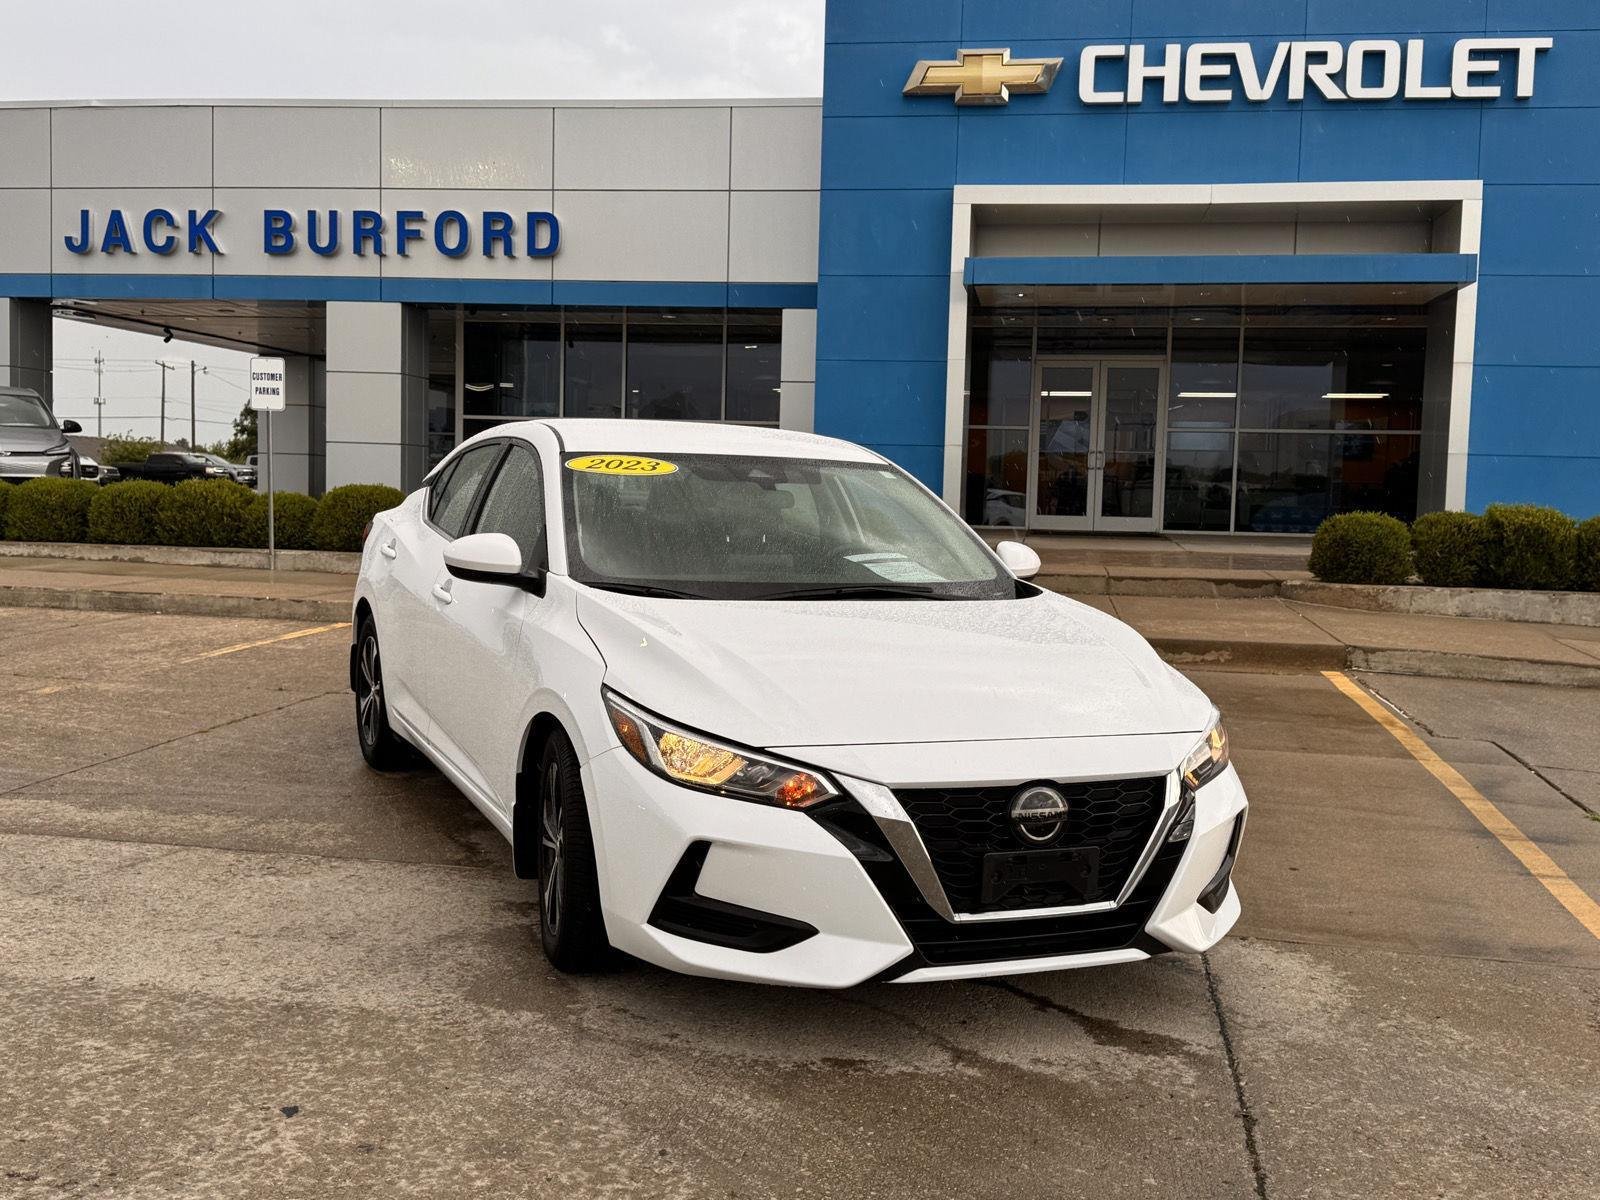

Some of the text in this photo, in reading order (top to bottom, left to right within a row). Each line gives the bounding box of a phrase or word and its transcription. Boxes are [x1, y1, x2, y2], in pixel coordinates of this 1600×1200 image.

[1078, 37, 1554, 104] CHEVROLET
[64, 208, 561, 258] JACK BURFORD
[252, 372, 283, 381] CUSTOMER
[255, 387, 280, 396] PARKING
[585, 458, 661, 472] 2023
